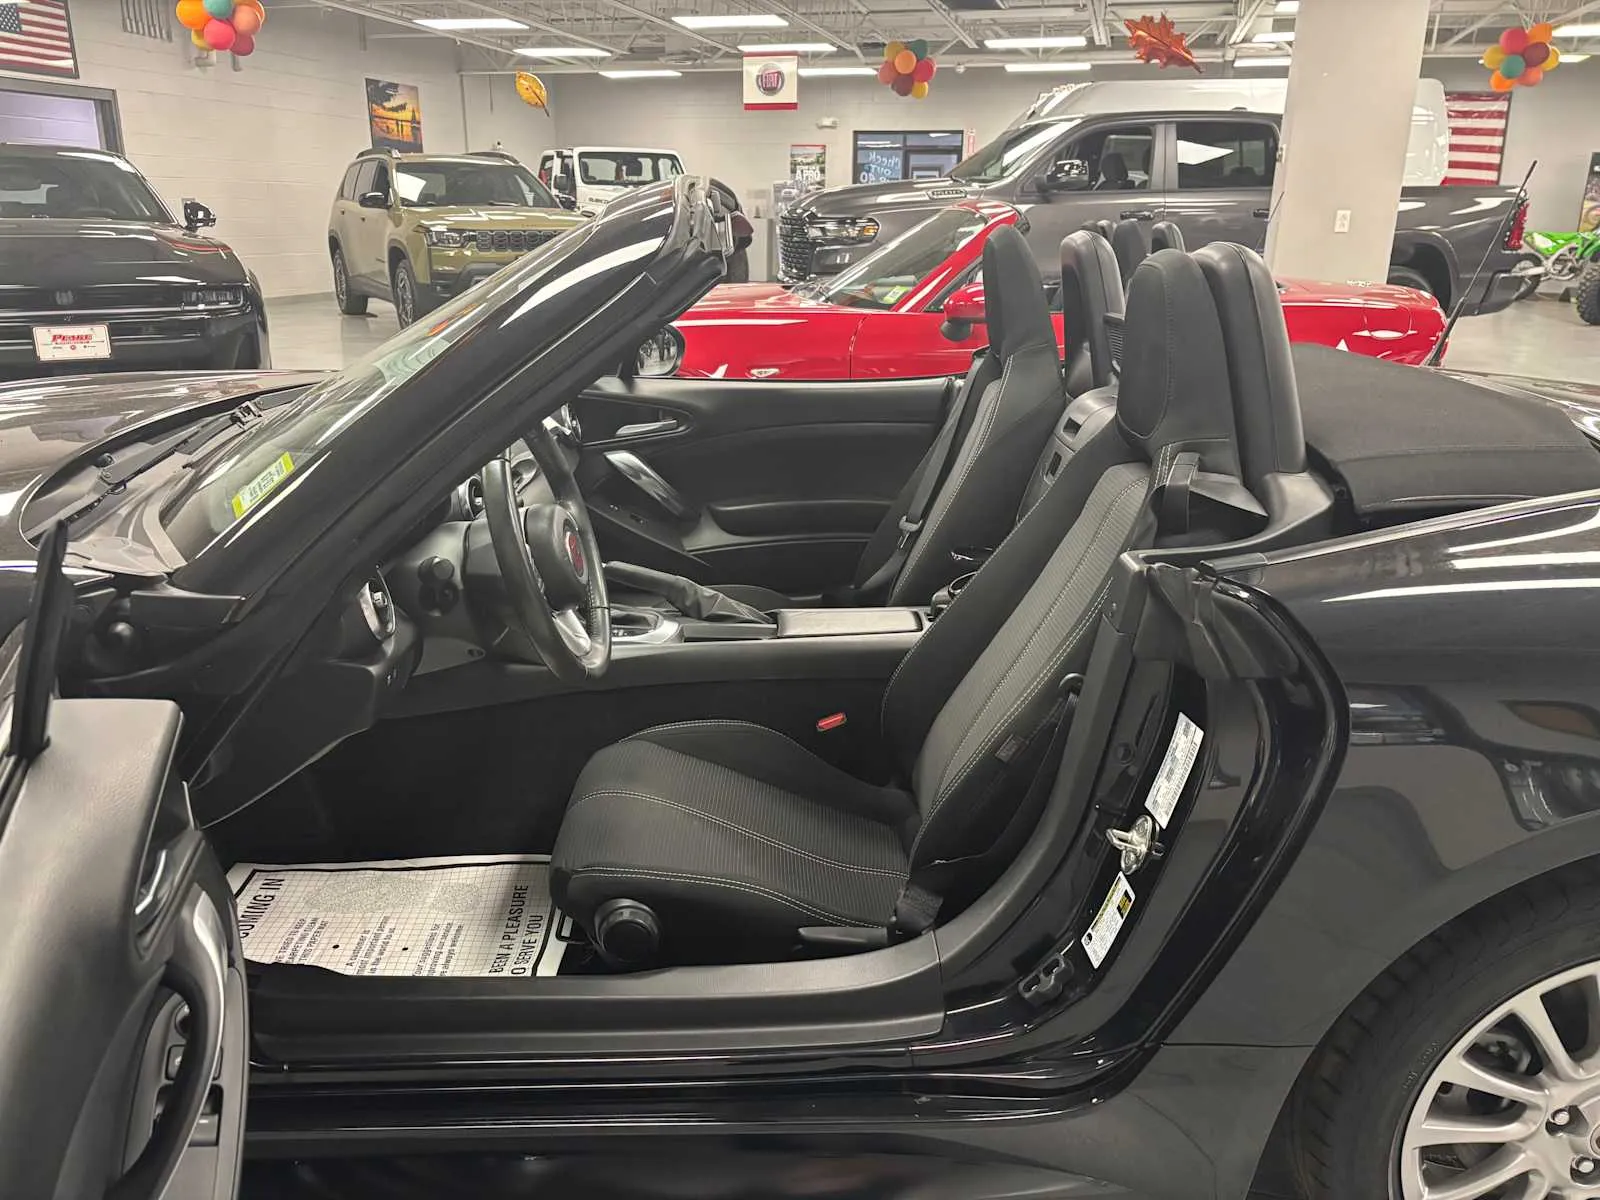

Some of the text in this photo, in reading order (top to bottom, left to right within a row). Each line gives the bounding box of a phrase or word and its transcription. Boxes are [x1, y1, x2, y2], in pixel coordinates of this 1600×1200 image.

[259, 878, 285, 890] IN
[488, 953, 511, 974] BEEN
[502, 885, 529, 941] PLEASURE
[524, 914, 544, 936] YOU
[514, 938, 538, 964] SERVE
